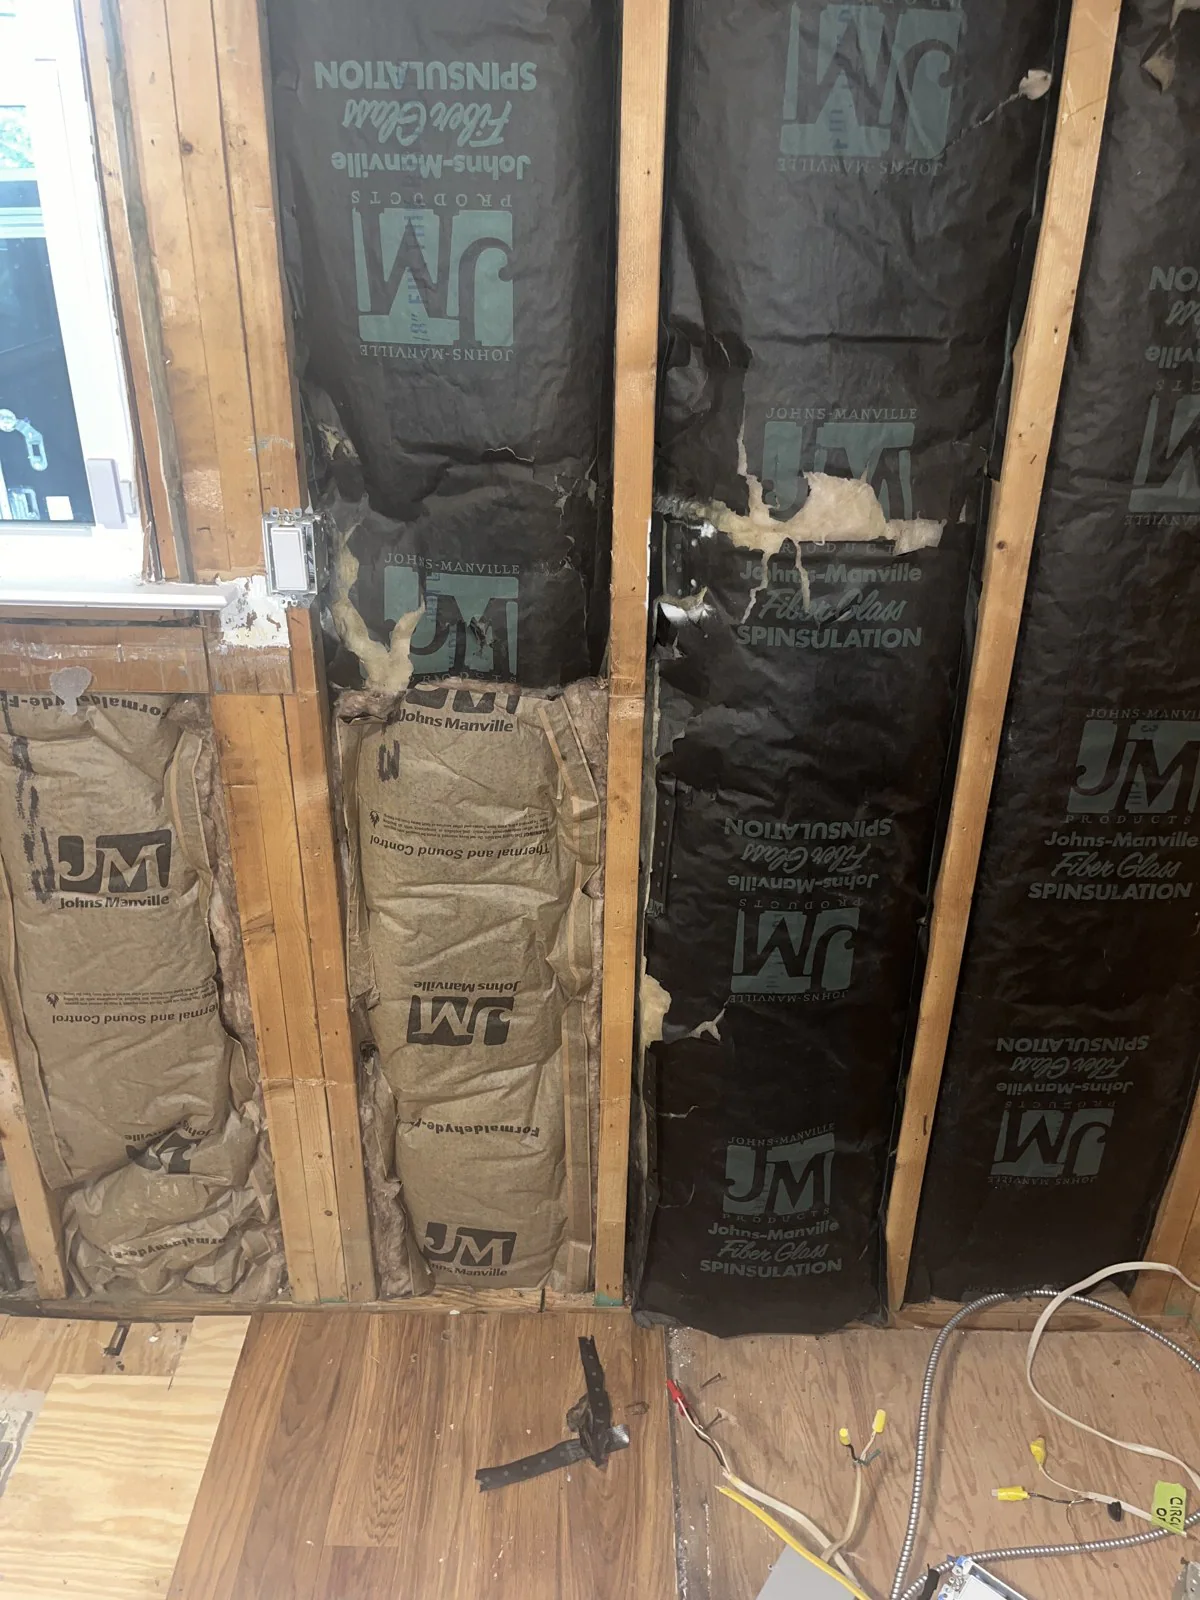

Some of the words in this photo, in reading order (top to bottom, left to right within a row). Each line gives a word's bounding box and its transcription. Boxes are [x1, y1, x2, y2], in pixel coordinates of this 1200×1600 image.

[314, 61, 537, 91] SPINSULATION
[780, 3, 962, 159] JM
[342, 99, 427, 146] Glass
[430, 101, 512, 148] Fiber
[331, 151, 531, 180] Johns-Manville
[351, 190, 513, 207] PRODUCTS
[352, 208, 513, 347] JM
[359, 344, 513, 361] JOHNS-MANVILLE
[766, 407, 917, 420] JOHNS-MANVILLE
[384, 553, 520, 575] JOHNS-MANVILLE
[736, 626, 922, 648] SPINSULATION
[398, 708, 443, 727] Johns
[445, 717, 514, 732] Manville
[1067, 719, 1200, 814] JM
[724, 817, 893, 840] SPINSULATION
[1064, 815, 1192, 825] PRODUCTS
[370, 835, 414, 856] Control
[1044, 831, 1200, 848] Johns-Manville
[58, 829, 172, 894] JM
[418, 846, 463, 860] Sound
[466, 850, 494, 860] and
[497, 843, 550, 859] Thermal
[740, 843, 808, 874] Glass
[811, 843, 871, 873] Fiber
[1051, 851, 1114, 878] Fiber
[1117, 852, 1183, 879] Glass
[728, 874, 879, 894] Johns-Manville
[1028, 882, 1193, 900] SPINSULATION
[58, 897, 102, 909] Johns
[105, 895, 170, 908] Manville
[739, 898, 863, 910] PRODUCTS
[731, 907, 860, 994] JM
[413, 981, 475, 993] Manville
[478, 981, 521, 993] Johns
[52, 1013, 100, 1024] Control
[104, 1014, 146, 1024] Sound
[150, 1013, 175, 1024] and
[178, 1002, 218, 1022] ermal
[407, 995, 515, 1046] JM
[996, 1035, 1149, 1052] SPINSULATION
[1010, 1056, 1070, 1079] Glass
[1073, 1056, 1129, 1079] Fiber
[996, 1081, 1133, 1096] Johns-Manville
[727, 1122, 835, 1146] JOHNS-MANVILLE
[990, 1108, 1115, 1177] JM
[723, 1132, 835, 1215] JM
[723, 1207, 830, 1224] PRODUCTS
[708, 1219, 840, 1240] Johns-Manville
[423, 1221, 517, 1266] JM
[718, 1240, 772, 1262] Fiber
[774, 1241, 829, 1262] Glass
[454, 1267, 508, 1277] Manville
[700, 1258, 842, 1277] SPINSULATION
